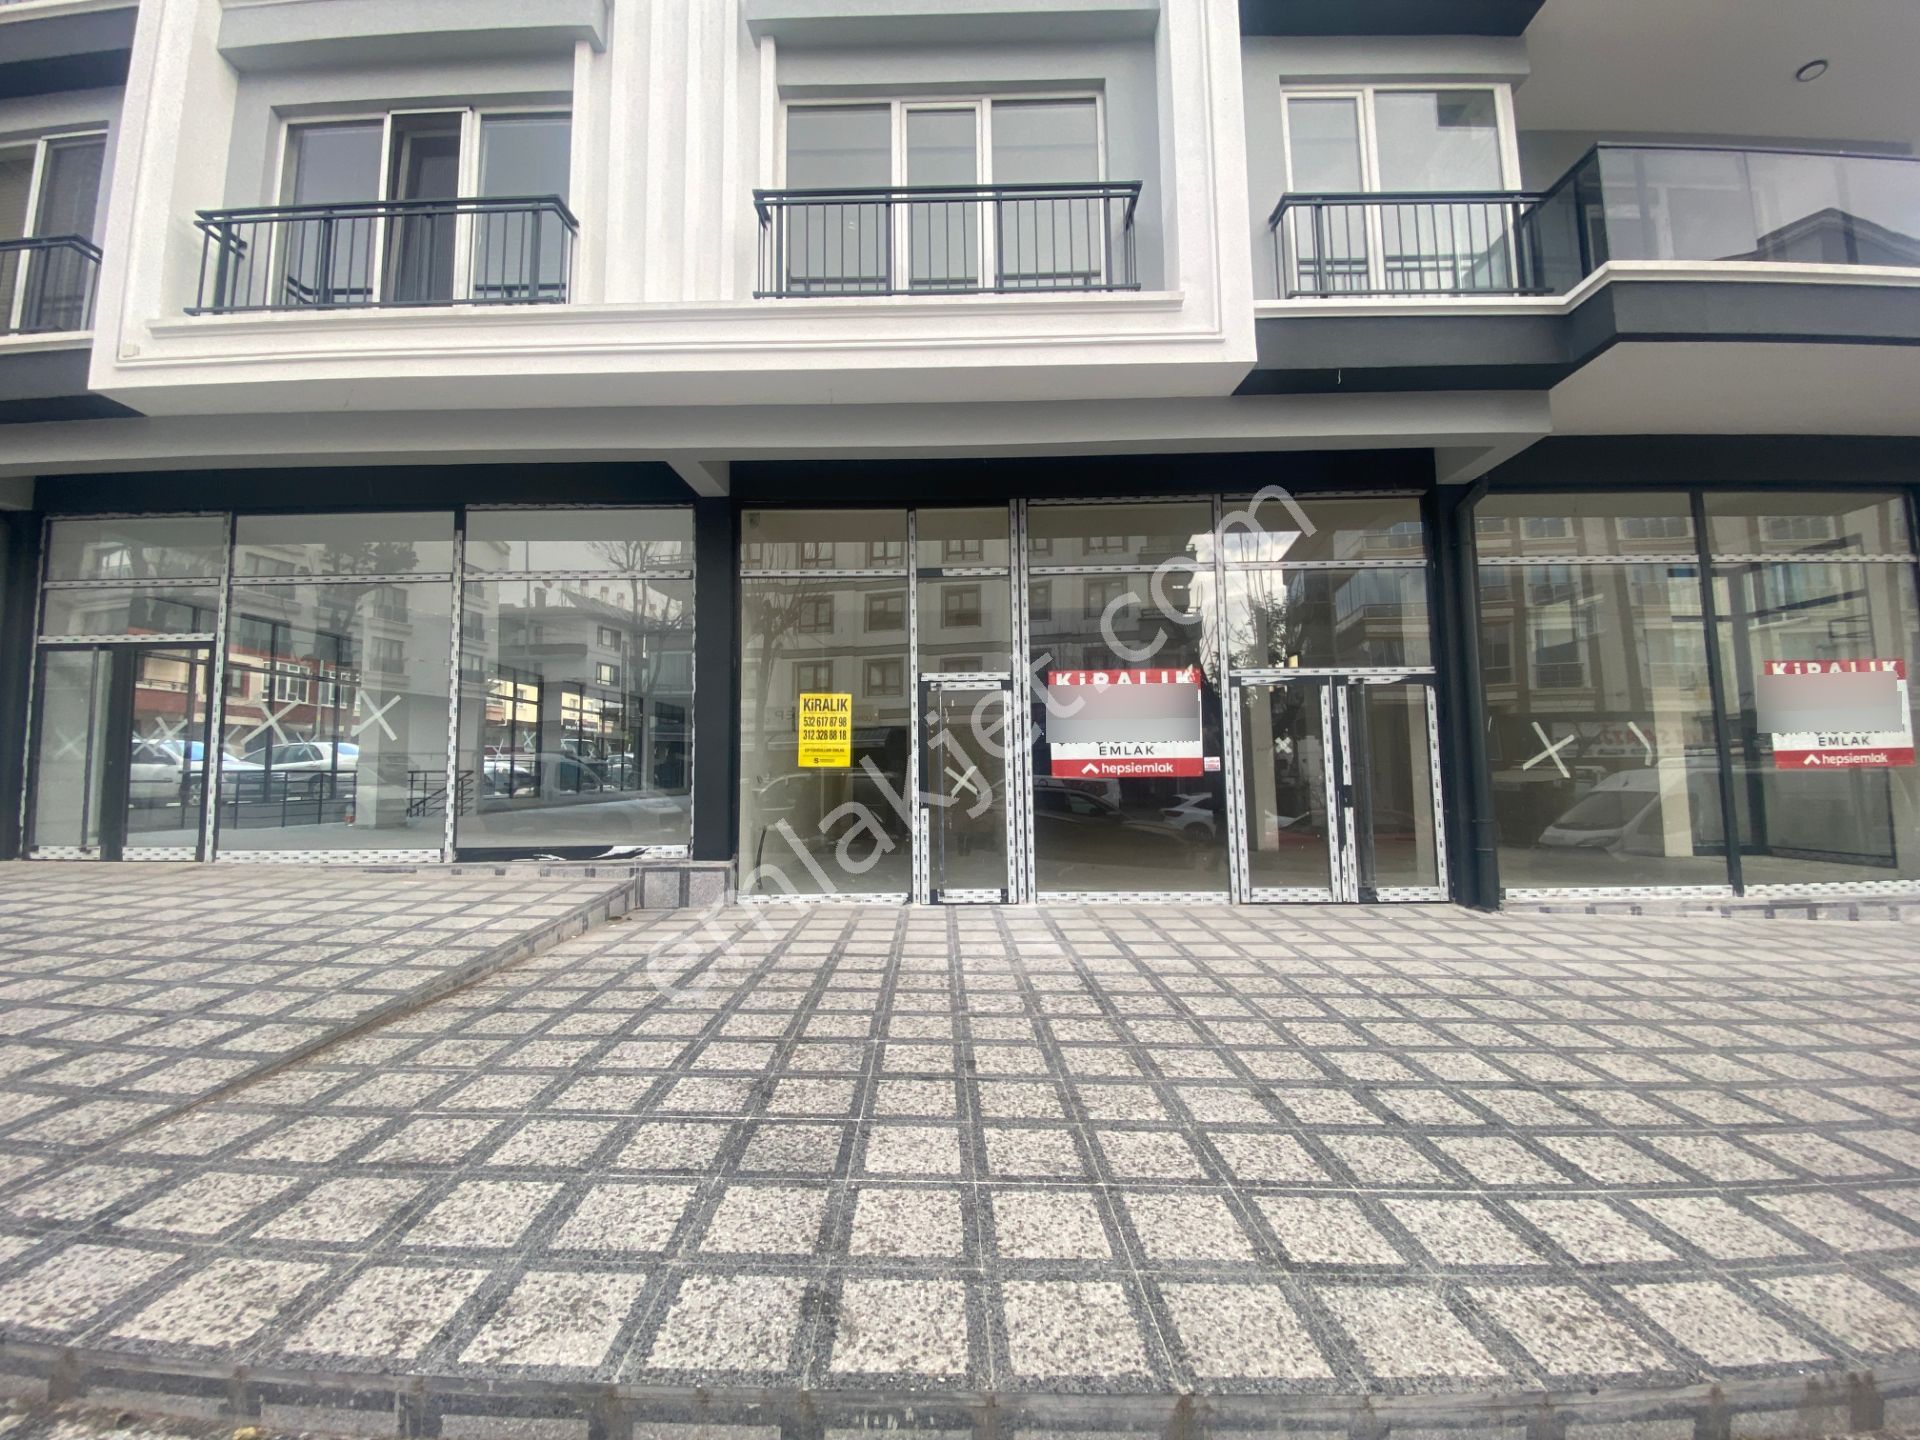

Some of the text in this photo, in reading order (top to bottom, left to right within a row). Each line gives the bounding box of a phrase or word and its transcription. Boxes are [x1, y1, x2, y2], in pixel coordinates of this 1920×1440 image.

[804, 716, 815, 727] 532
[816, 716, 828, 727] 617
[803, 729, 815, 740] 312
[1818, 736, 1870, 747] EMLAK
[1099, 745, 1154, 756] EMLAK
[1822, 753, 1888, 766] hepsiemlak
[1101, 762, 1174, 775] hepsiemlak
